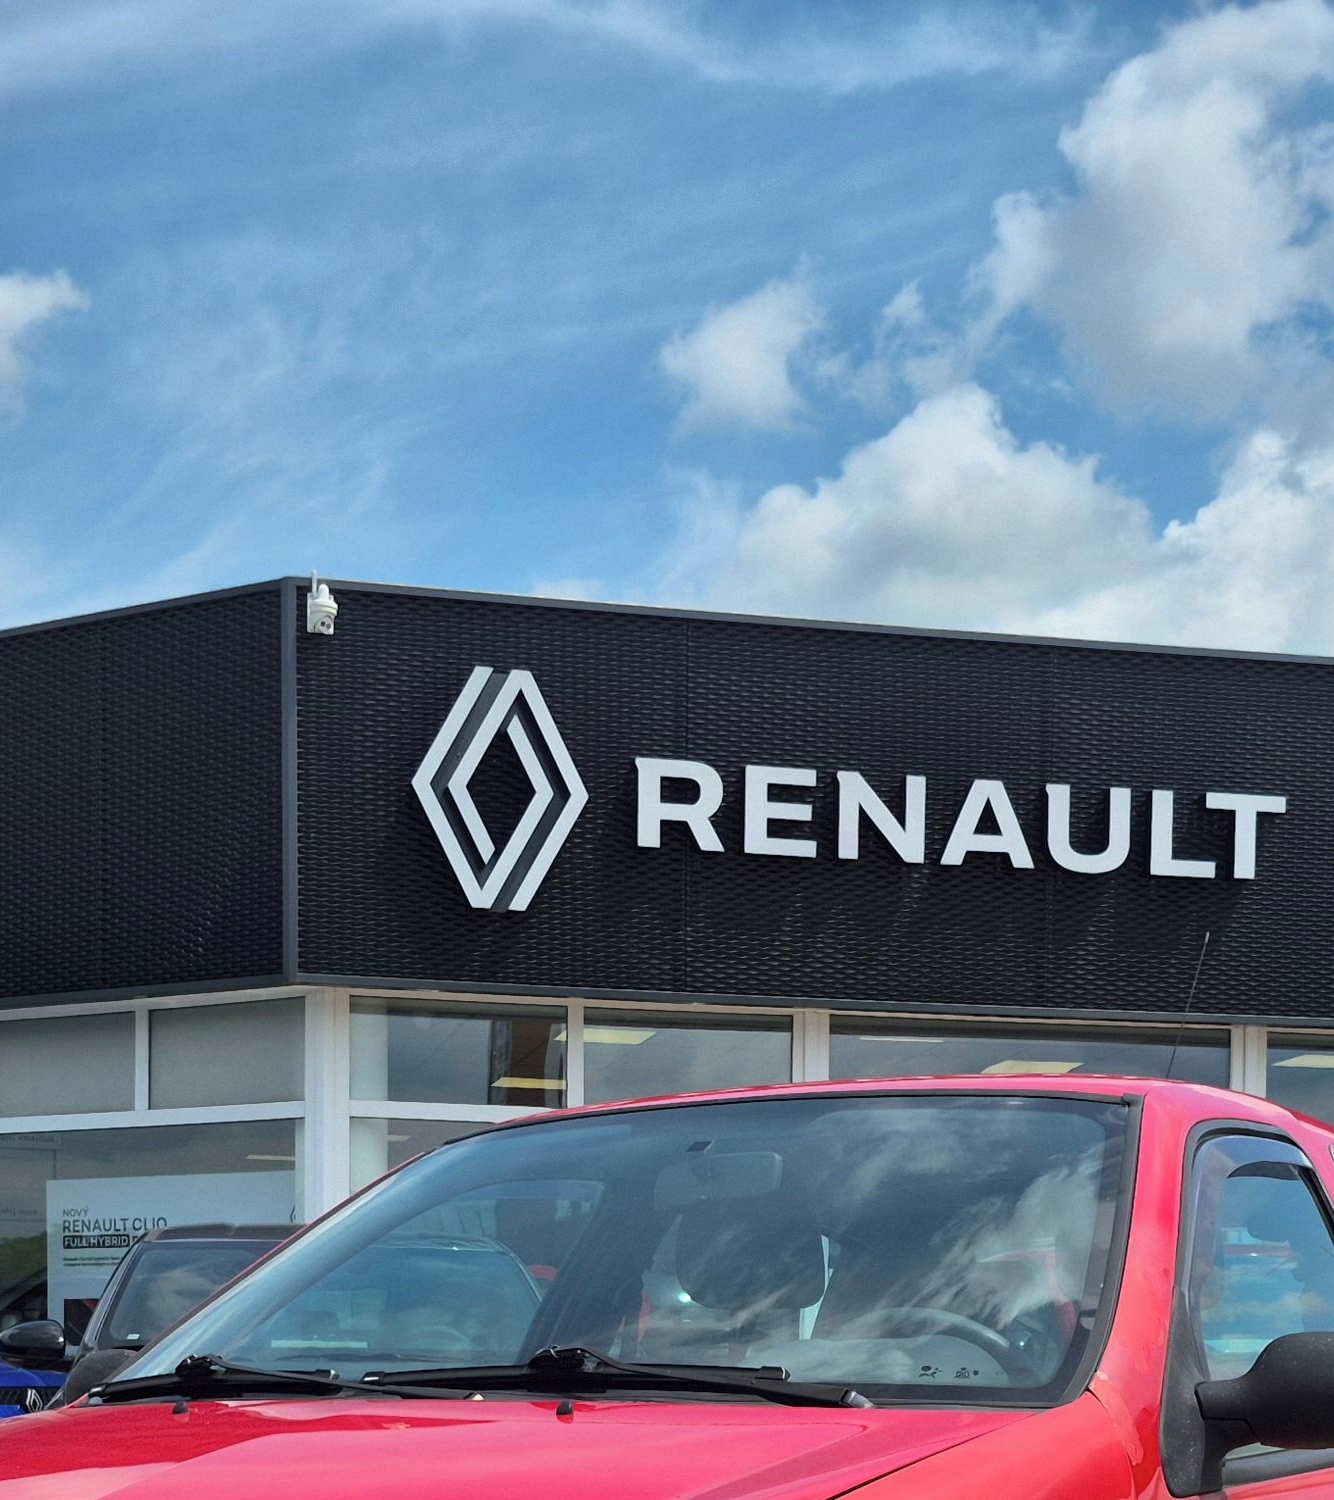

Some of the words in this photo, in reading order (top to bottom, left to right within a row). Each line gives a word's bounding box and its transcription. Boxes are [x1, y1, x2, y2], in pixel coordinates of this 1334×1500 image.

[635, 756, 1287, 881] RENAULT
[62, 1206, 88, 1217] NOVÝ
[62, 1218, 129, 1233] RENAULT
[64, 1237, 89, 1248] FULL
[90, 1236, 128, 1247] HYBRID
